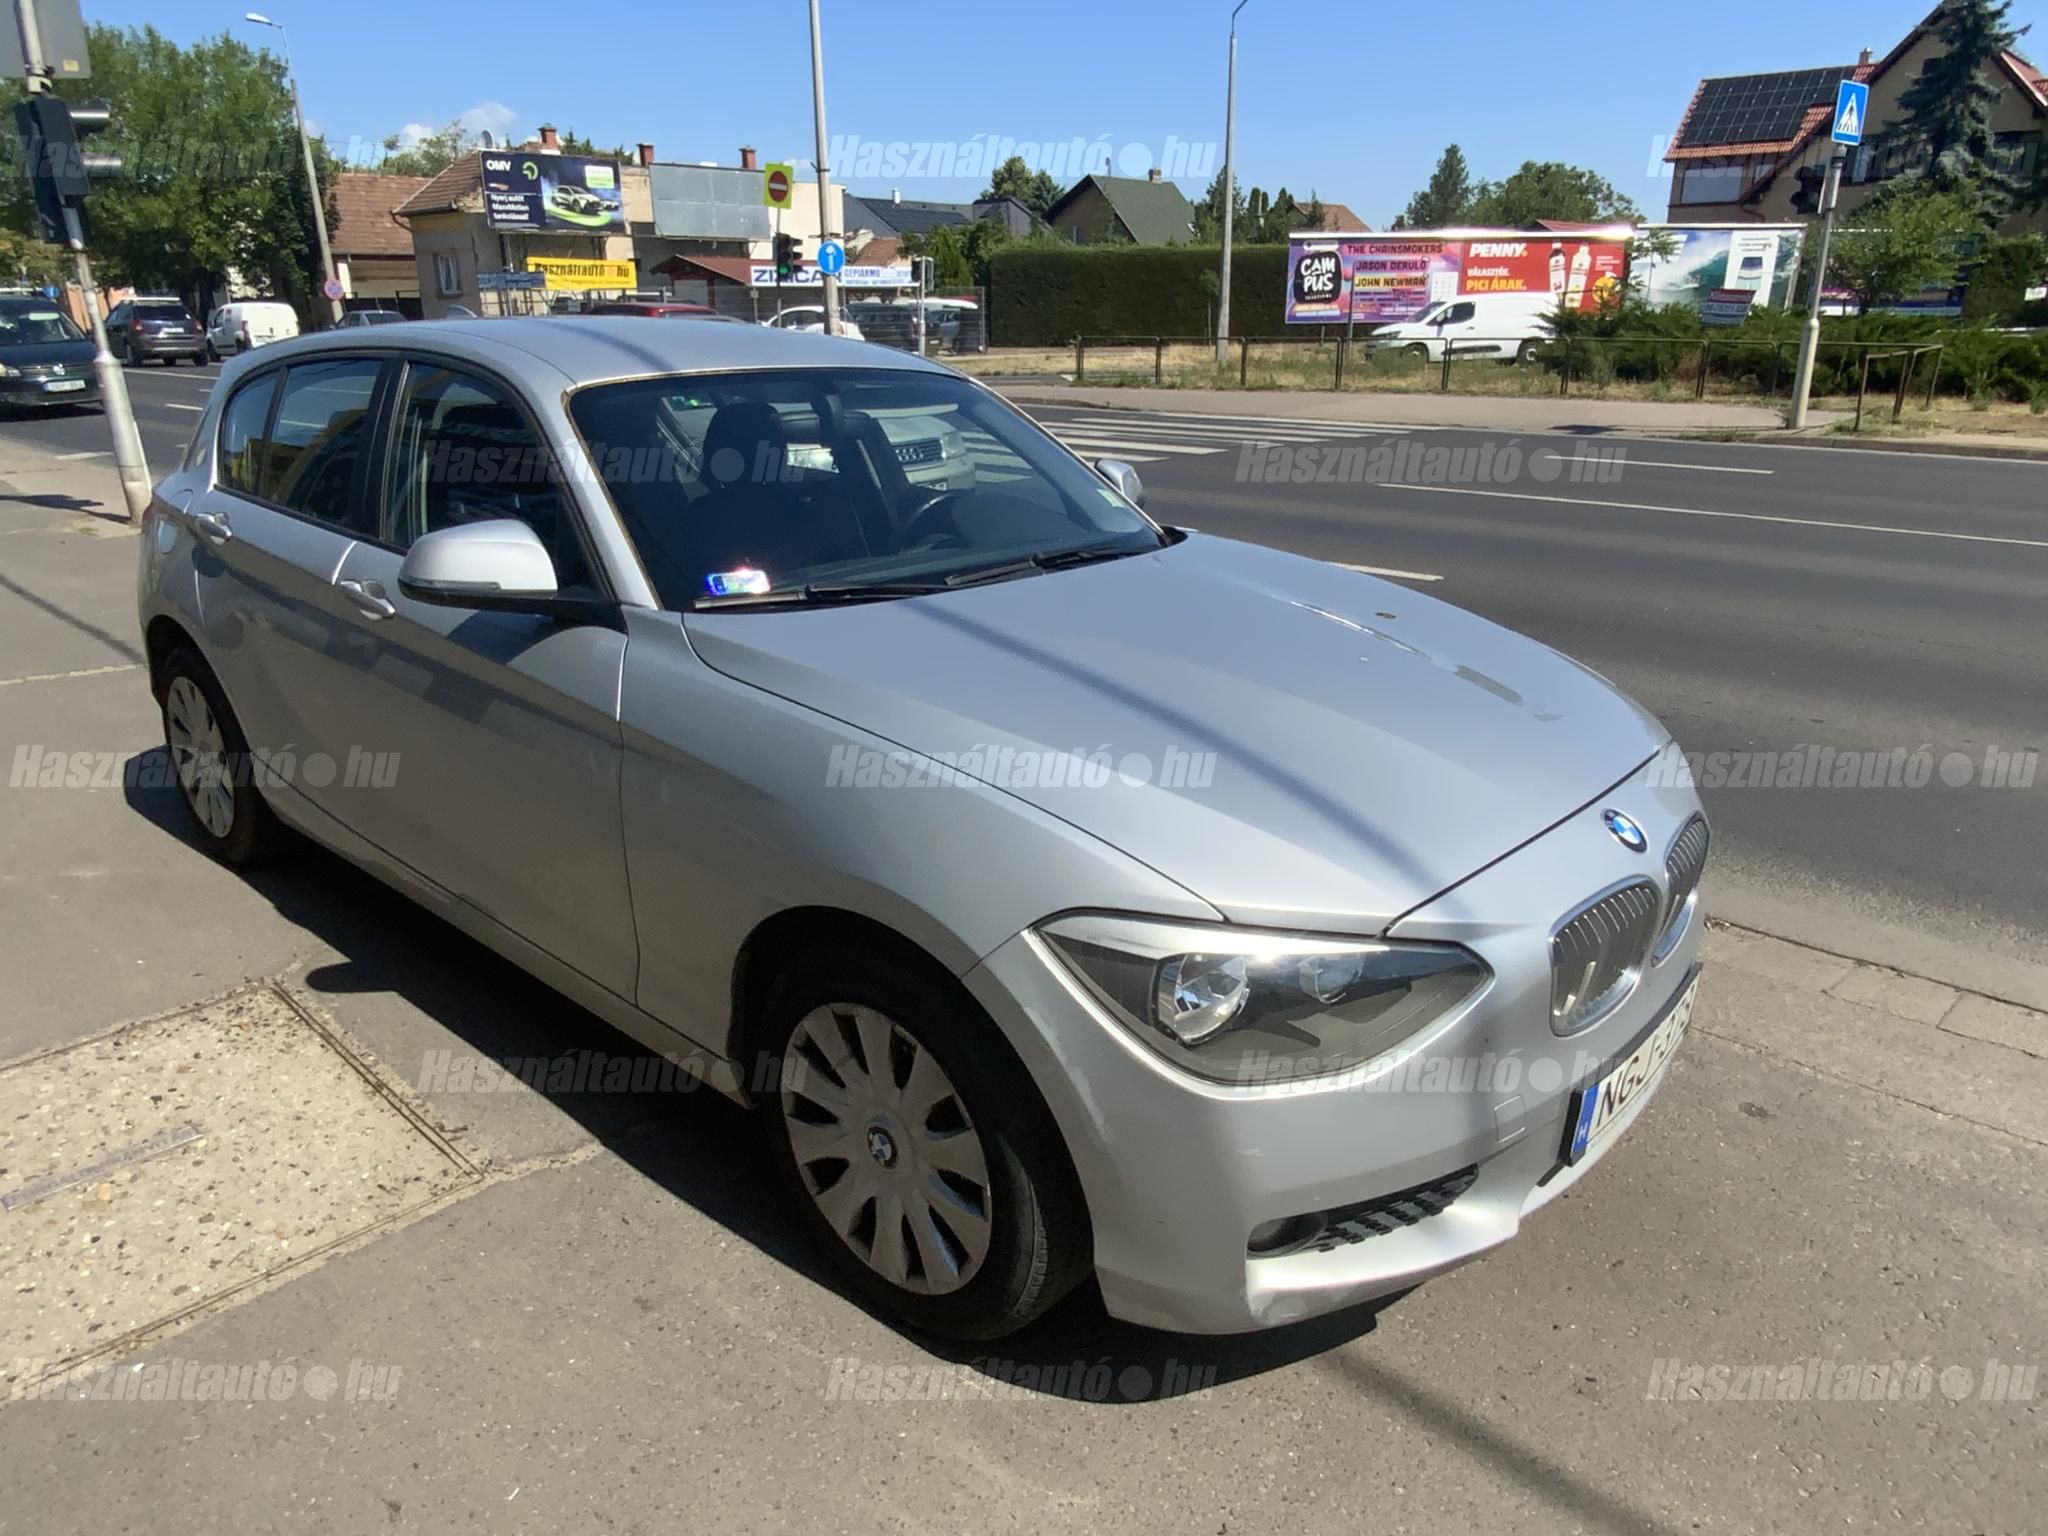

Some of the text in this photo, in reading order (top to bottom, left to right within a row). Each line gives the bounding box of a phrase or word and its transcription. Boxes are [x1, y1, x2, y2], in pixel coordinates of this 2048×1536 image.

[486, 160, 511, 171] OMV
[1347, 244, 1443, 254] THE CHAINSMOKERS
[1300, 257, 1336, 276] CAM
[1356, 260, 1427, 271] JASON DERULO
[1303, 273, 1334, 293] PUS
[1355, 276, 1426, 287] JOHN NEWMAN
[1466, 279, 1490, 291] PICI
